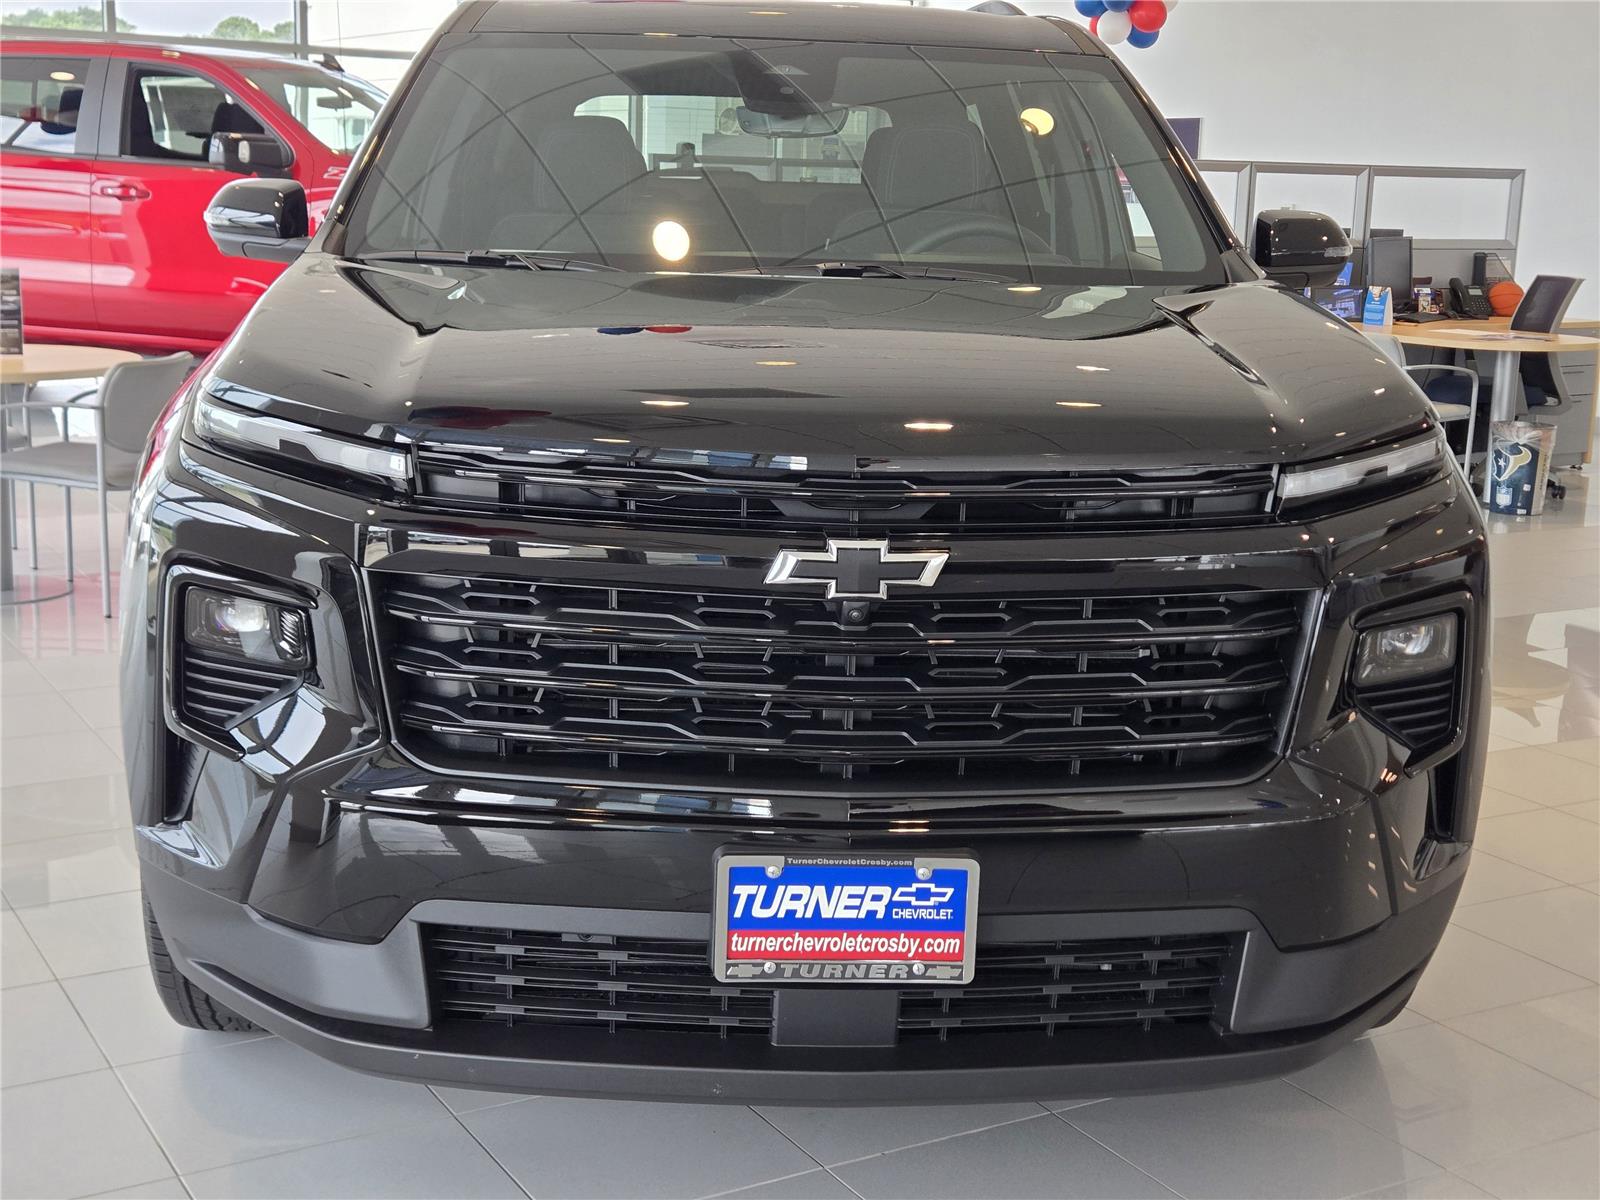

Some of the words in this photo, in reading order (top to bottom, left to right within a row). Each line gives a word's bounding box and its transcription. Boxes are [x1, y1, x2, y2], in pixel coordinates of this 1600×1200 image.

[787, 858, 912, 867] TurnerChevroletCrosby.com
[733, 885, 892, 919] TURNER
[892, 908, 953, 919] CHEVROLET
[731, 932, 960, 957] turnerchevroletcrosby.com
[780, 964, 909, 978] TURNER
